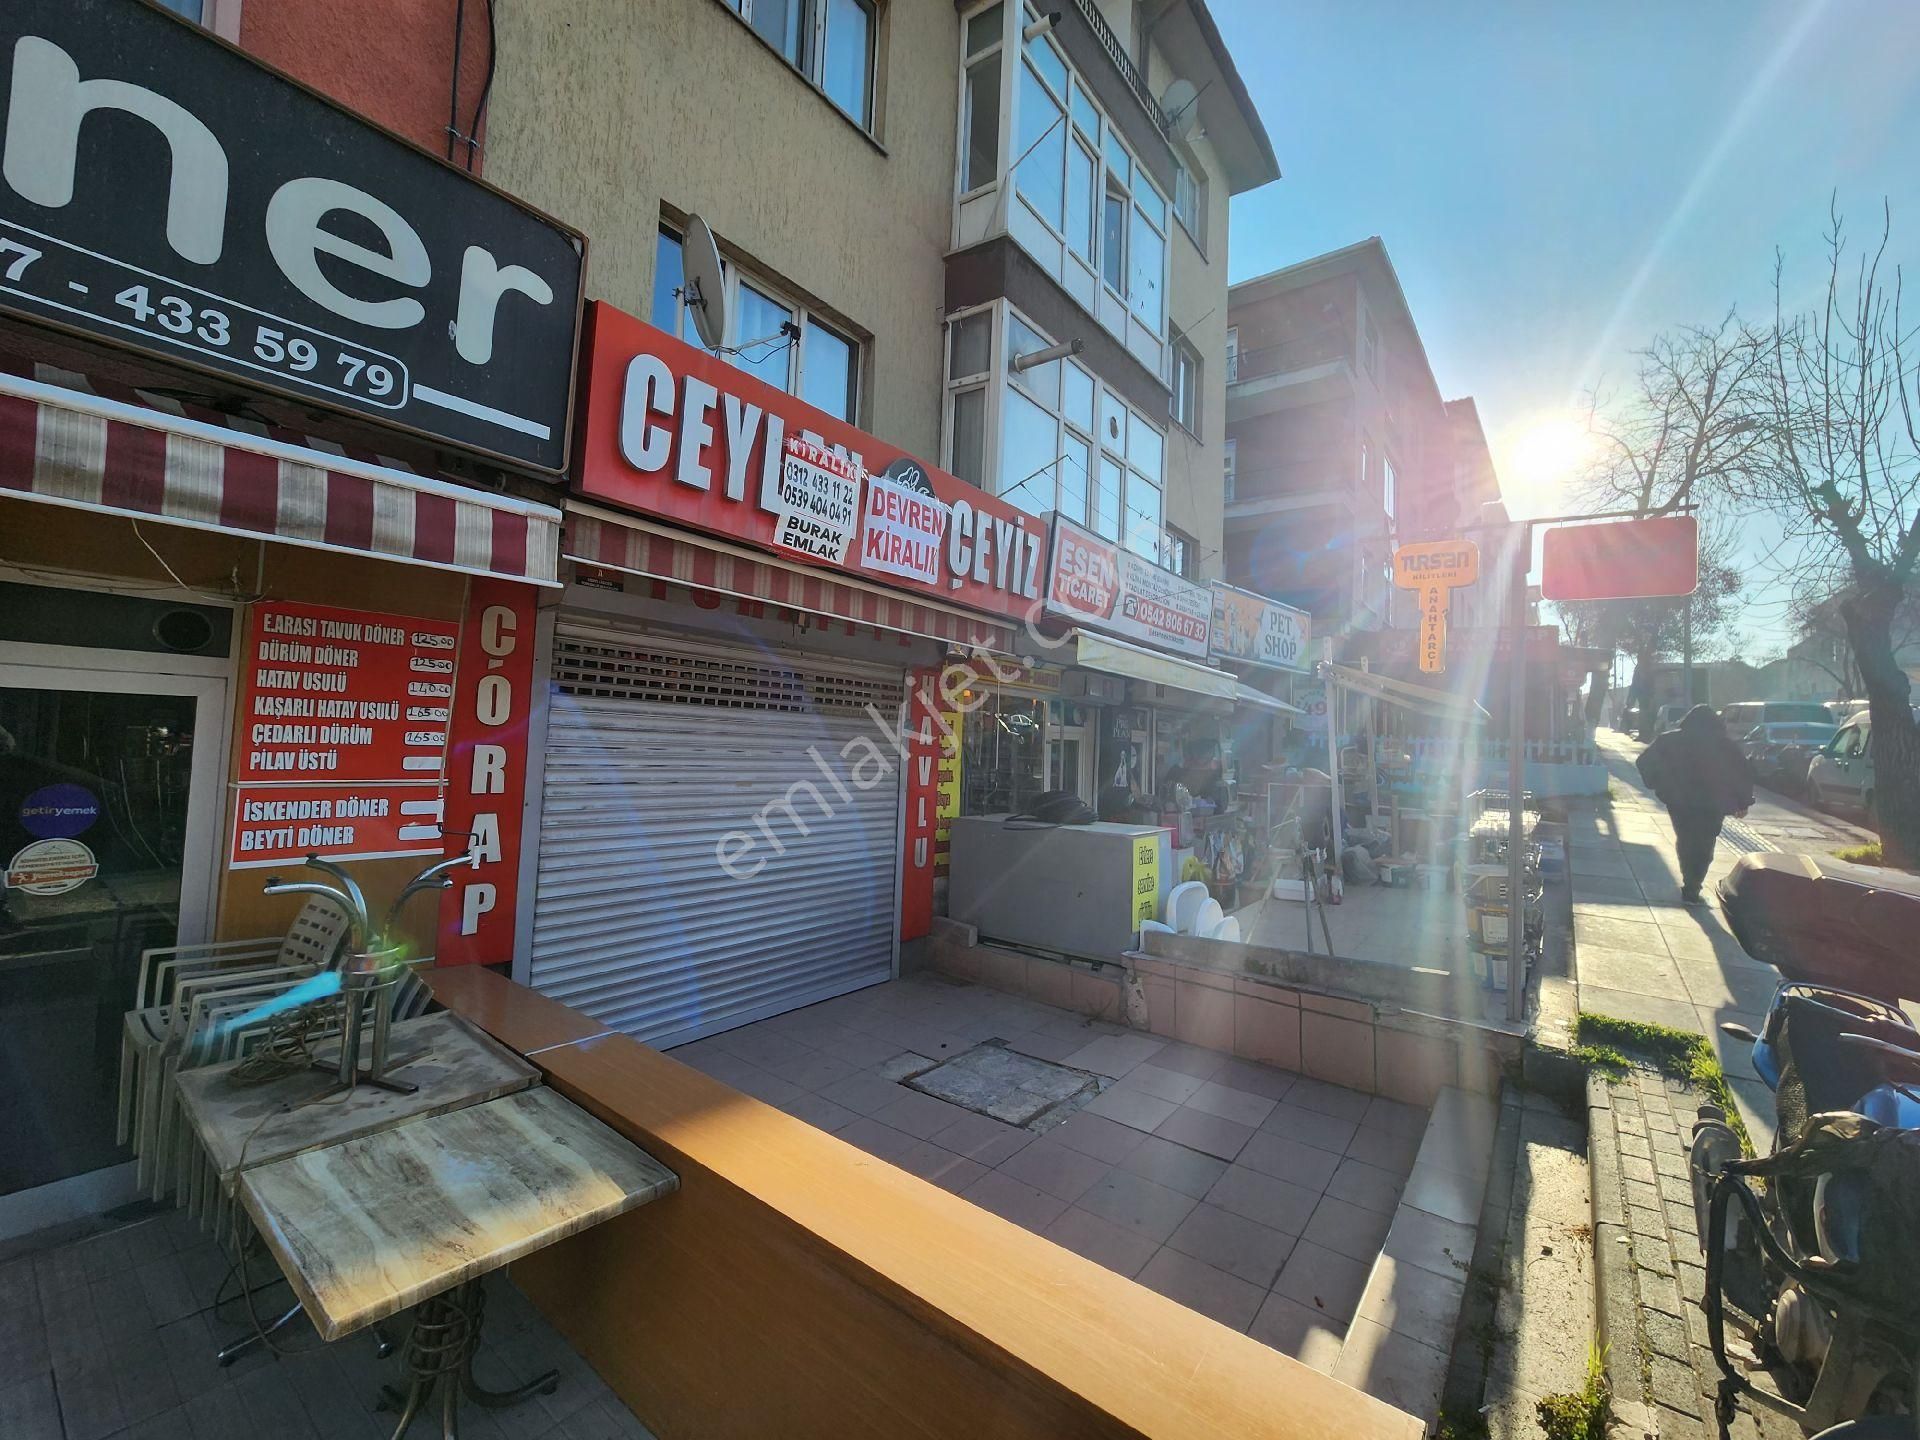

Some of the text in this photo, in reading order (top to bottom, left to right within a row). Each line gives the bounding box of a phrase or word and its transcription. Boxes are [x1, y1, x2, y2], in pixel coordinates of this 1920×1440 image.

[2, 35, 554, 365] ner
[115, 284, 231, 347] 433
[253, 324, 319, 373] 59
[336, 352, 394, 396] 79
[786, 461, 853, 505] 0312 433 11 22
[783, 483, 852, 526] 0539 404 04 91
[871, 485, 943, 538] DEVREN
[782, 532, 840, 561] EMLAK
[786, 515, 843, 545] BURAK
[948, 497, 1042, 600] ÇEYİZ
[1059, 539, 1115, 590] ESEN
[1057, 571, 1111, 608] TİCARET
[263, 613, 405, 646] E.ARASI TAVUK DÖNER
[1140, 602, 1165, 627] 0542
[1165, 612, 1183, 633] 806
[1183, 618, 1195, 637] 67
[1194, 623, 1205, 640] 32
[1270, 611, 1293, 636] PET
[1427, 586, 1439, 669] ANAHTARCI
[258, 639, 359, 668] DÜRÜM DÖNER
[1264, 634, 1297, 660] SHOP
[256, 668, 347, 692] HATAY USULÜ
[253, 696, 400, 721] KAŞARLI HATAY USULÜ
[251, 723, 373, 747] ÇEDARLI DÜRÜM
[249, 748, 338, 770] PİLAV ÜSTÜ
[460, 605, 517, 936] ÇORAP
[913, 675, 935, 868] HAVLU
[22, 805, 97, 817] getiryemek
[243, 796, 390, 822] İSKENDER DÖNER
[240, 824, 355, 851] BEYTİ DÖNER
